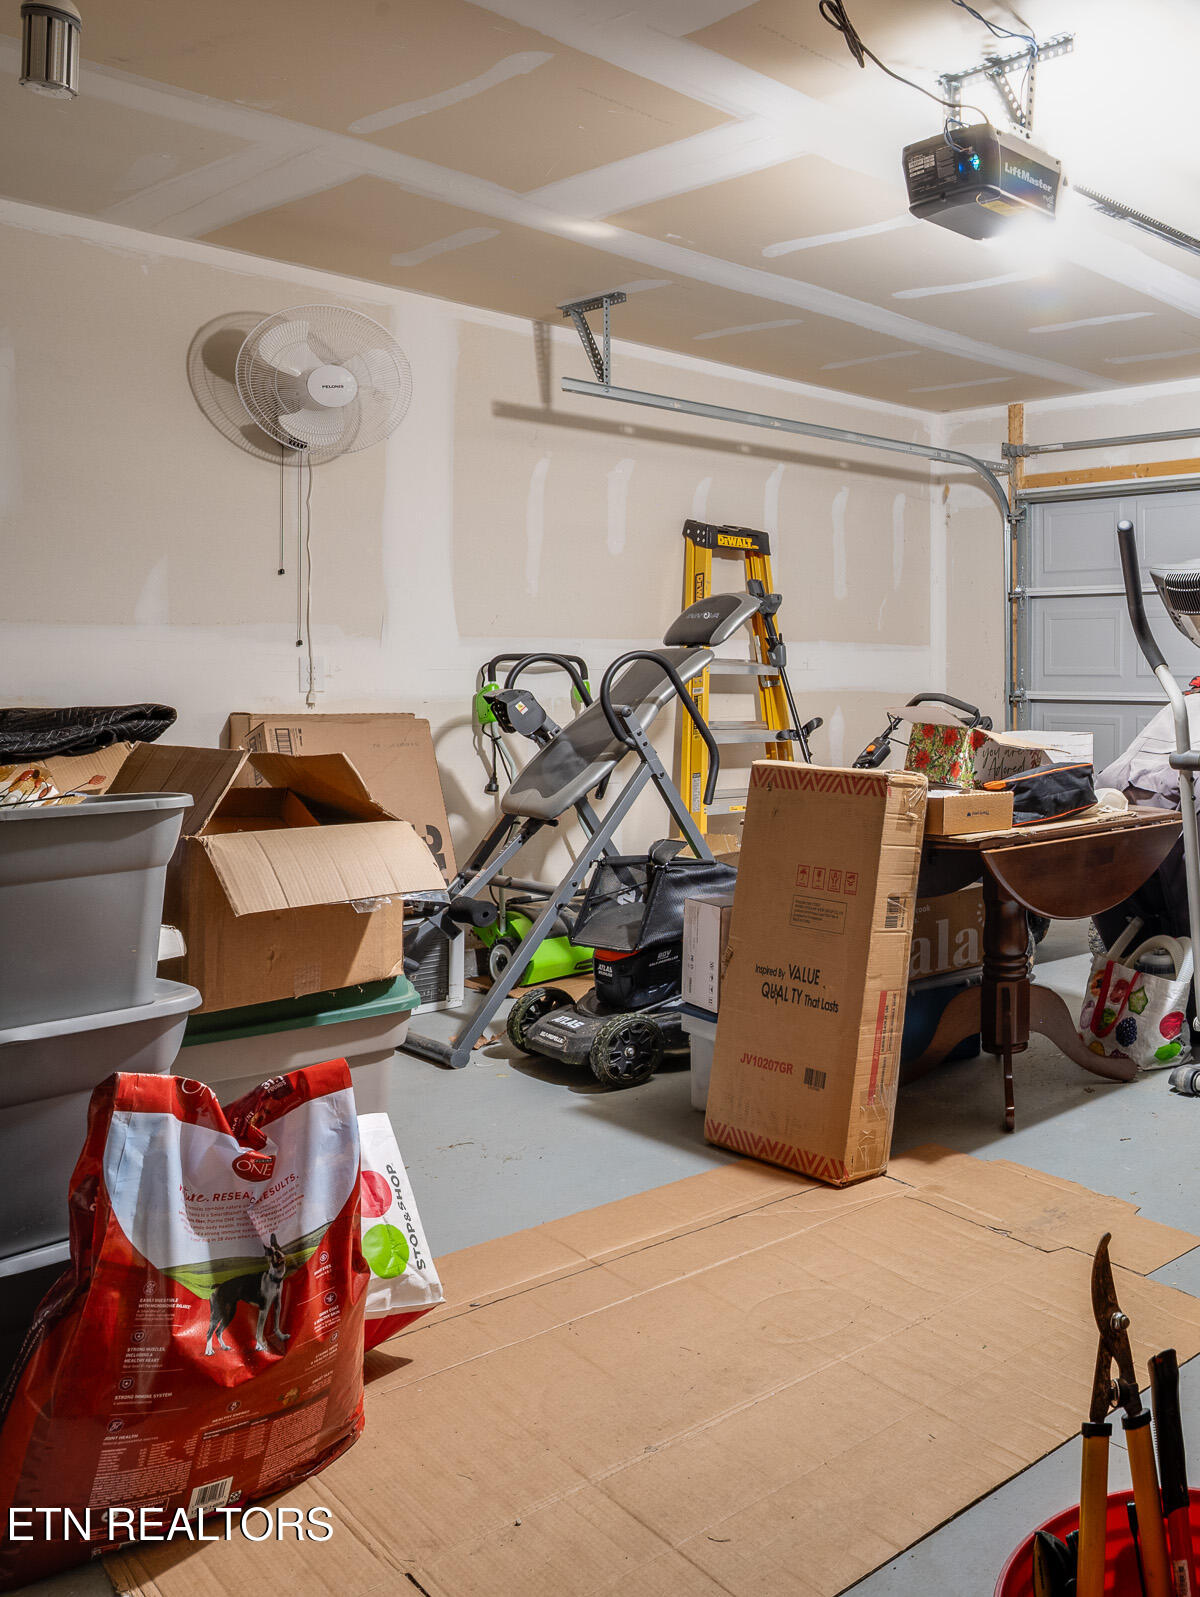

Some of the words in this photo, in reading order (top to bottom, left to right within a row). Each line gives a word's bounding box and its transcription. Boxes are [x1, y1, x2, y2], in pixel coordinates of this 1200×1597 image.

[1004, 162, 1053, 194] LiftMaster
[982, 747, 1000, 768] you
[755, 963, 778, 978] Inspired
[778, 967, 786, 980] By
[788, 963, 821, 986] VALUE
[804, 994, 820, 1010] That
[820, 999, 839, 1013] Lasts
[740, 1052, 793, 1075] JV10207GR
[236, 1160, 273, 1176] ONE
